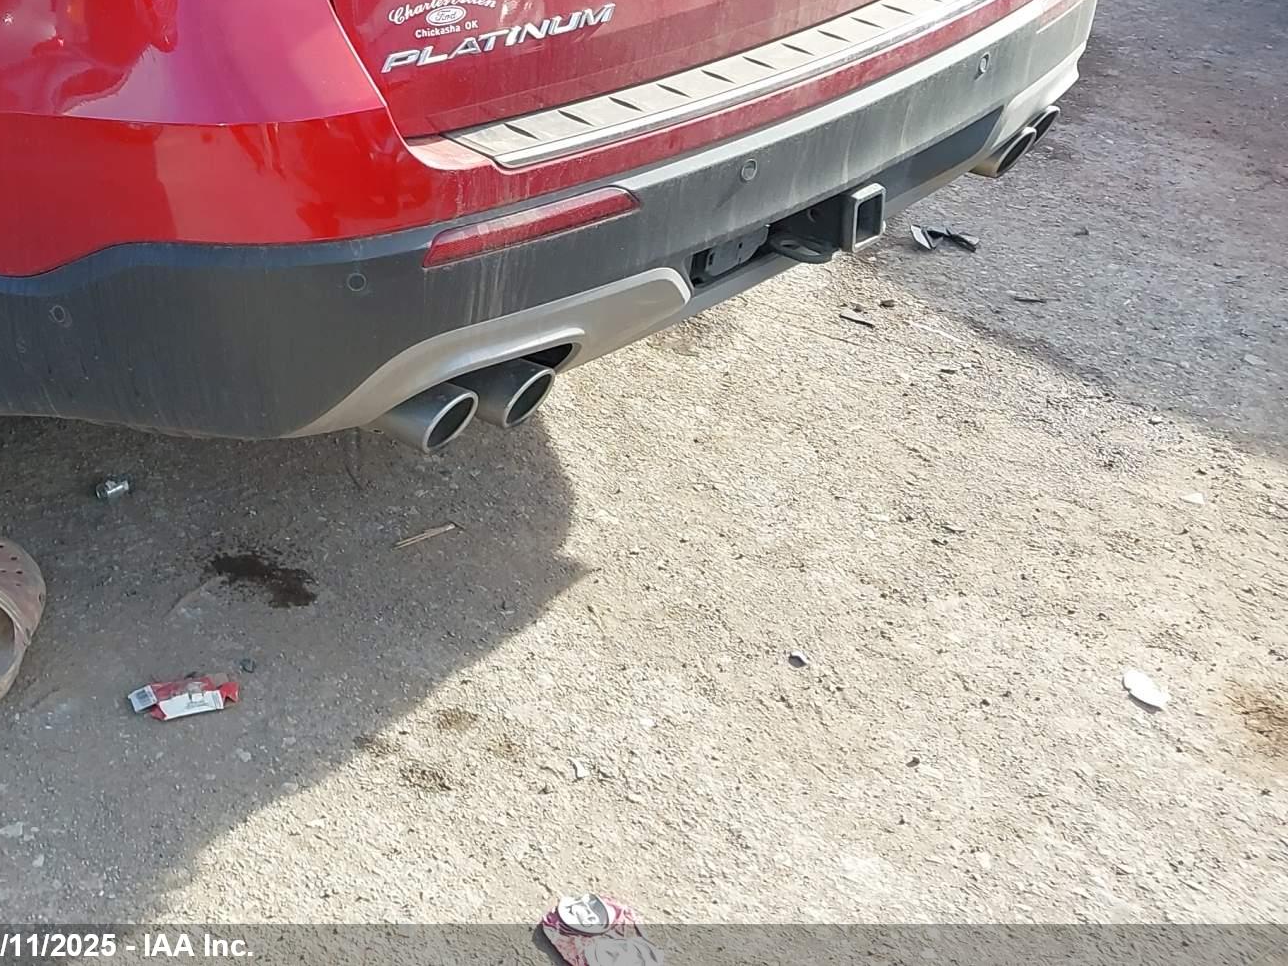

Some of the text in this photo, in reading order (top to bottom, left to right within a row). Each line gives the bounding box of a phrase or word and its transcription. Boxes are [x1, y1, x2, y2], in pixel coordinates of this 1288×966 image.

[380, 2, 617, 74] PLATINUM
[415, 19, 479, 39] Chickasha OK
